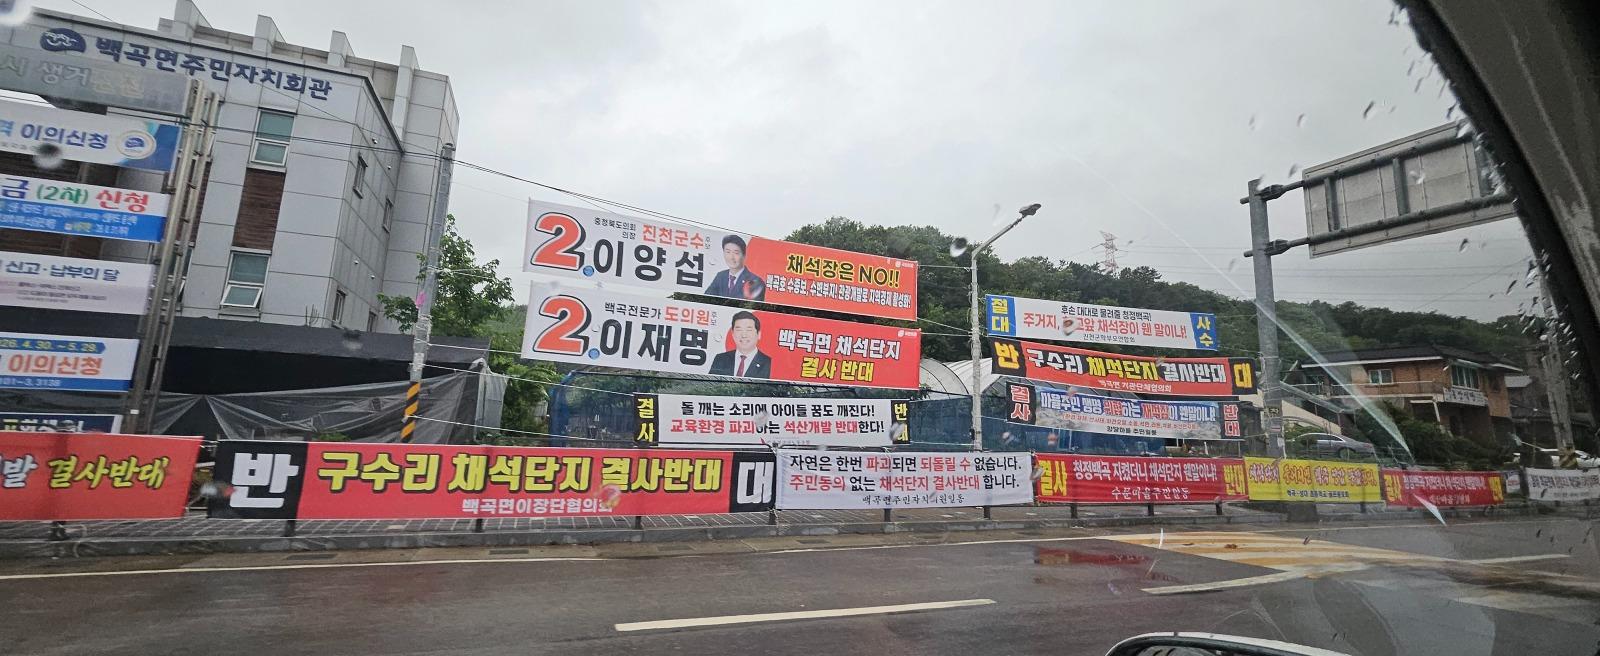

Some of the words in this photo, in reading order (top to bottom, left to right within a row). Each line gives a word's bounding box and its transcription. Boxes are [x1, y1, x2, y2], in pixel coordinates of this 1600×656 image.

[95, 36, 333, 101] 백곡면주민자치회관
[21, 124, 109, 149] 이의신청
[1, 177, 30, 199] 금
[37, 184, 89, 205] (2차)
[96, 189, 149, 213] 신청
[530, 212, 586, 271] 2
[642, 224, 704, 250] 진천군수
[6, 260, 99, 281] 신고·납부의
[103, 269, 120, 281] 달
[593, 239, 704, 288] 이양섭
[786, 253, 854, 281] 채석장은
[859, 265, 901, 288] NO!!
[766, 274, 786, 291] 백곡호
[788, 278, 808, 296] 수중보,
[839, 284, 868, 303] 관광개발로
[868, 288, 892, 306] 지역경제
[533, 294, 592, 356] 2
[605, 302, 662, 320] 백곡전문가
[664, 306, 710, 327] 도의원
[991, 298, 1010, 333] 절대
[1024, 312, 1060, 330] 주거지,
[1062, 316, 1094, 332] 교앞
[1098, 319, 1139, 335] 채석장이
[1142, 322, 1152, 336] 웬
[1154, 323, 1187, 338] 말이냐!
[1061, 305, 1076, 316] 후손
[1077, 307, 1098, 317] 대대로
[1122, 310, 1152, 322] 청정백곡!
[600, 318, 709, 367] 이재명
[778, 328, 832, 354] 백곡면
[835, 334, 901, 360] 채석단지
[1197, 316, 1214, 347] 사수
[8, 354, 103, 375] 이의신청
[801, 357, 837, 379] 결사
[840, 360, 875, 382] 반대
[994, 341, 1020, 370] 반
[1026, 348, 1083, 374] 구수리
[1087, 355, 1159, 381] 채석단지
[1163, 361, 1227, 384] 결사반대
[1233, 364, 1253, 389] 대
[681, 402, 694, 416] 돌
[698, 402, 724, 416] 깨는
[772, 404, 807, 418] 아이들
[811, 405, 834, 418] 꿈도
[837, 404, 875, 417] 깨진다!
[1010, 385, 1030, 422] 결사
[1041, 392, 1081, 412] 마을주민
[637, 398, 655, 443] 결사
[671, 419, 725, 434] 교육환경
[784, 420, 832, 434] 석산개발
[835, 420, 885, 434] 반대한다!
[1224, 404, 1240, 437] 반대
[3, 454, 38, 488] 발
[48, 454, 170, 489] 결사반대
[318, 452, 441, 492] 구수리
[448, 452, 592, 492] 채석단지
[602, 457, 722, 491] 결사반대
[790, 455, 831, 472] 자연은
[836, 455, 861, 472] 한번
[866, 456, 916, 472] 파괴되면
[921, 457, 956, 471] 되돌릴
[960, 457, 970, 471] 수
[974, 456, 1021, 472] 없습니다.
[1038, 460, 1067, 496] 결사
[1073, 460, 1111, 479] 청정백곡
[1114, 462, 1148, 482] 지켰더니
[1150, 463, 1182, 482] 채석단지
[1184, 463, 1217, 482] 웬말이냐!
[230, 452, 299, 508] 반
[736, 461, 773, 504] 대
[789, 474, 845, 491] 주민동의
[850, 476, 875, 491] 없는
[879, 474, 929, 490] 채석단지
[932, 476, 979, 490] 결사반대
[983, 475, 1020, 489] 합니다.
[1223, 465, 1245, 495] 반대
[863, 494, 964, 505] 백곡면주민자치원일동
